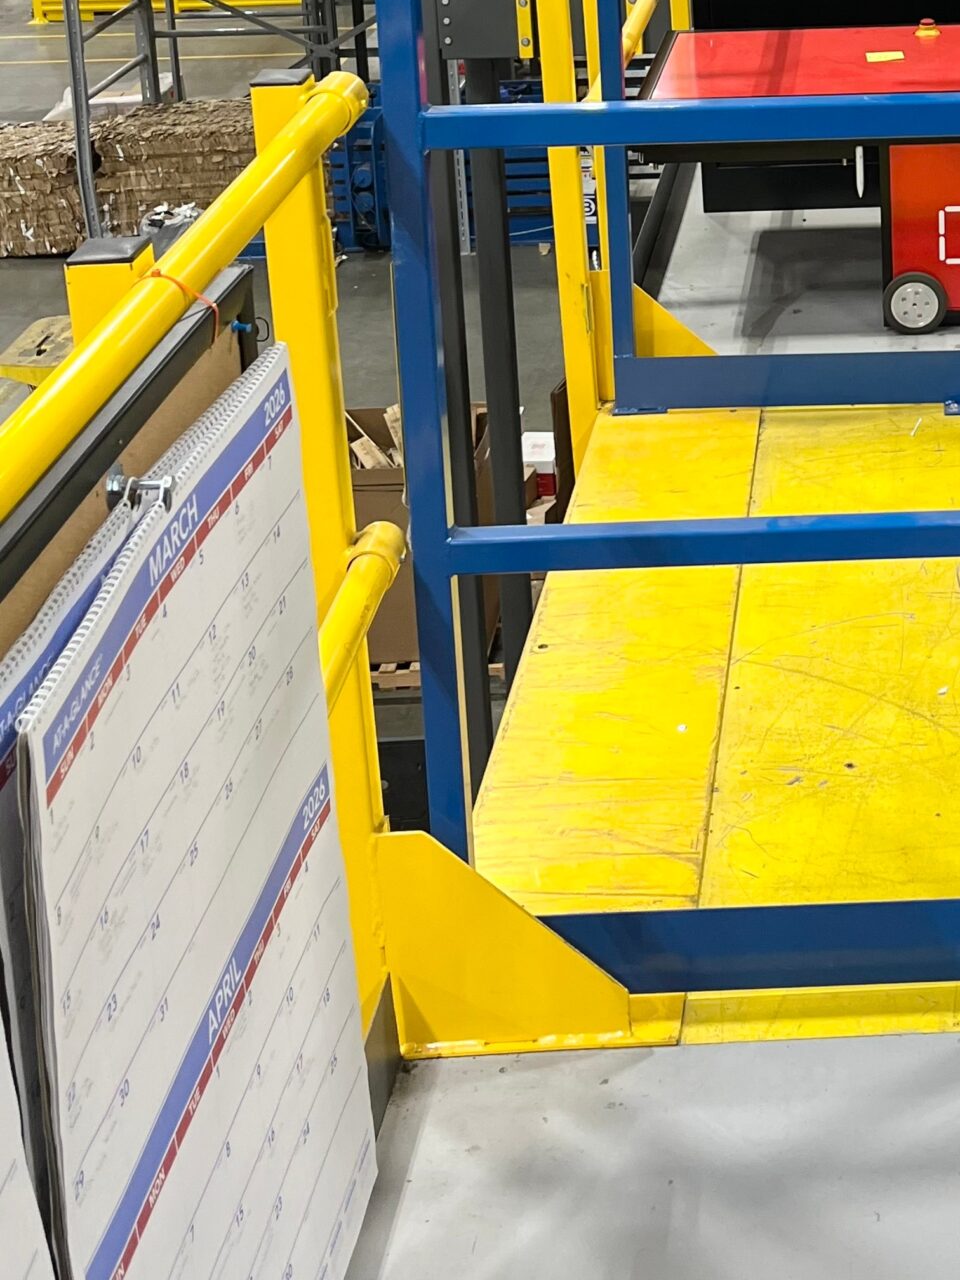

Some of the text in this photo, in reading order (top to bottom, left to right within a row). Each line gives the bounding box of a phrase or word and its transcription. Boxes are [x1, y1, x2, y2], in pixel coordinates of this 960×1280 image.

[148, 493, 199, 587] MARCH
[263, 381, 286, 428] 2026
[199, 549, 204, 565] 5
[60, 422, 285, 779] SUN MON TUE WED THU FRI SAT
[132, 745, 142, 769] 10
[171, 682, 181, 704] 11
[208, 624, 217, 645] 12
[241, 572, 249, 592] 13
[273, 524, 281, 544] 14
[140, 828, 150, 854] 17
[180, 761, 190, 785] 18
[217, 700, 226, 721] 19
[248, 645, 257, 668] 20
[278, 595, 287, 616] 21
[106, 992, 118, 1023] 23
[150, 912, 161, 942] 24
[189, 840, 199, 867] 25
[254, 718, 262, 741] 27
[206, 777, 326, 1045] APRIL 2026
[286, 985, 294, 1007] 10
[313, 923, 321, 943] 11
[118, 1077, 130, 1108] 30
[159, 996, 169, 1023] 31
[147, 1166, 166, 1209] MON
[187, 1083, 201, 1117] TUE
[221, 1008, 236, 1041] WED
[253, 938, 265, 966] THU
[310, 816, 321, 842] SAT
[236, 1202, 244, 1228] 15
[275, 1195, 283, 1221] 23
